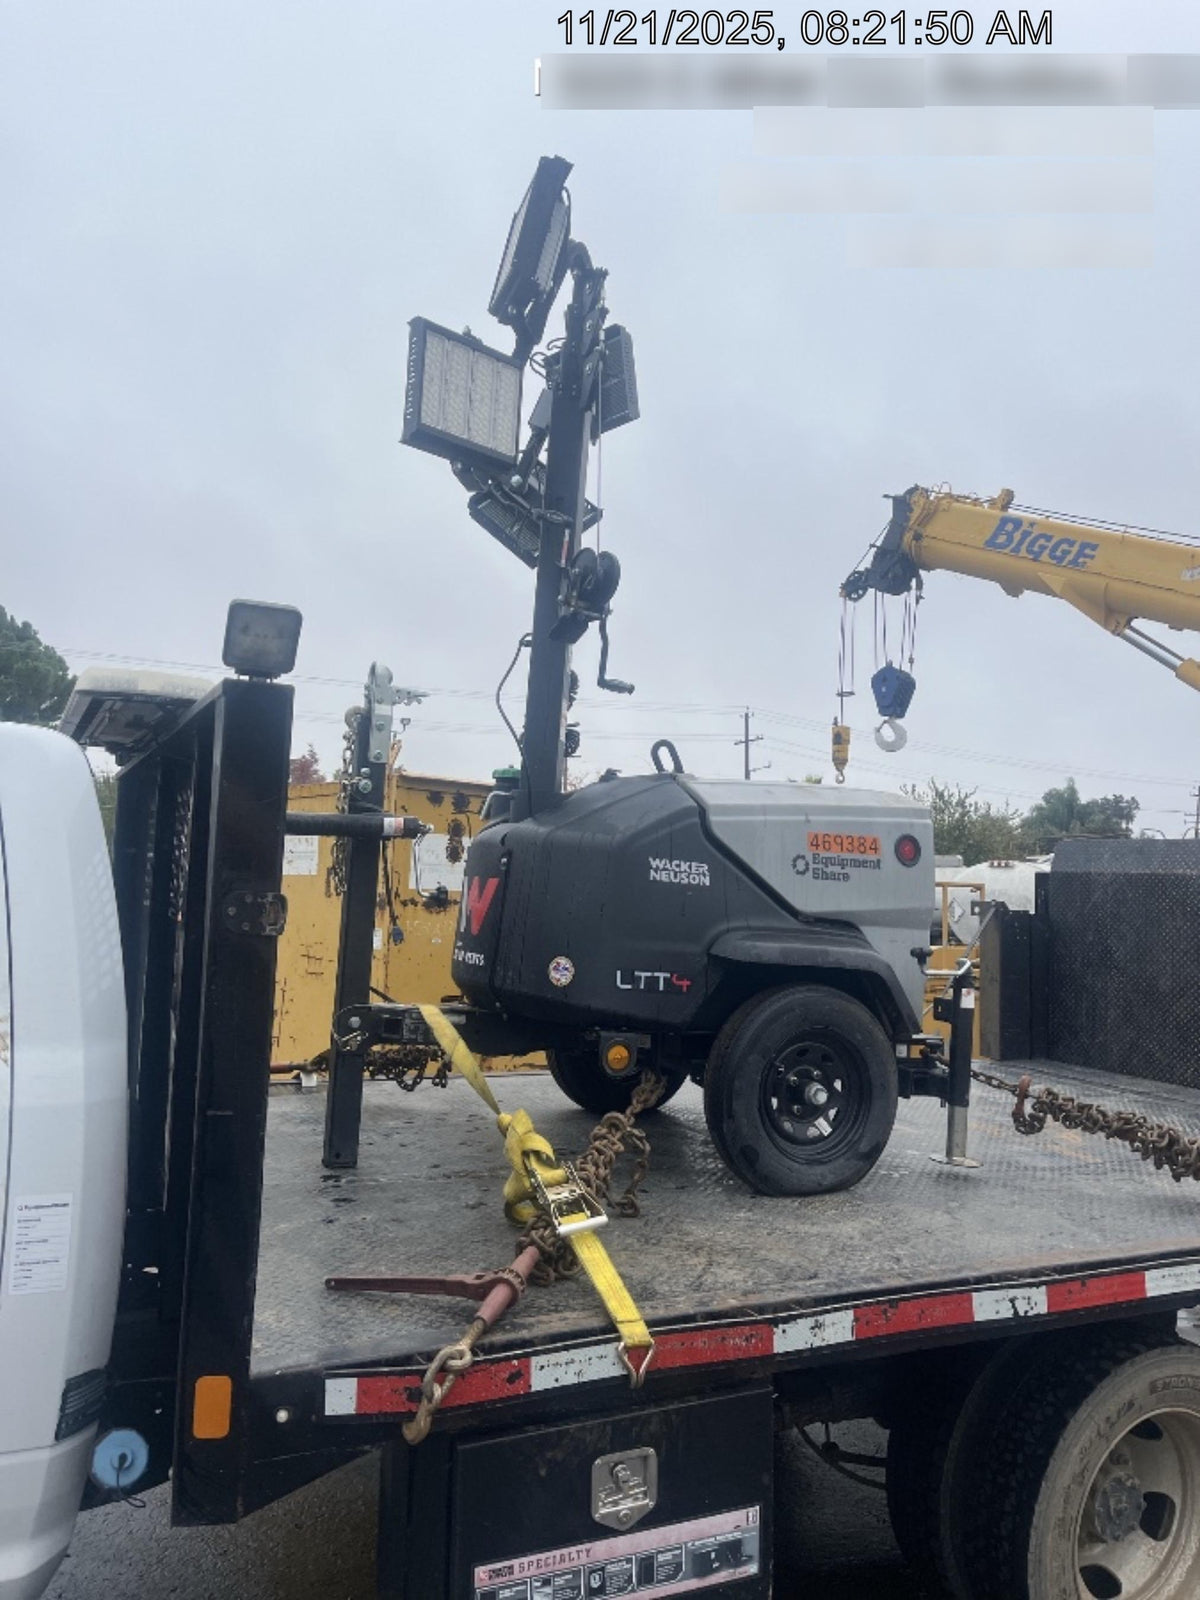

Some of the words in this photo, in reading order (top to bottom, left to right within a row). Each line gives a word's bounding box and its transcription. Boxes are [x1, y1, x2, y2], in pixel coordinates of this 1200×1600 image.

[810, 833, 879, 855] 469384
[648, 856, 710, 875] WACKER
[812, 852, 881, 871] Equipment
[650, 869, 710, 886] NEUSON
[812, 867, 851, 882] Share
[616, 970, 692, 993] LTT4
[518, 1546, 593, 1575] SPECIALTY
